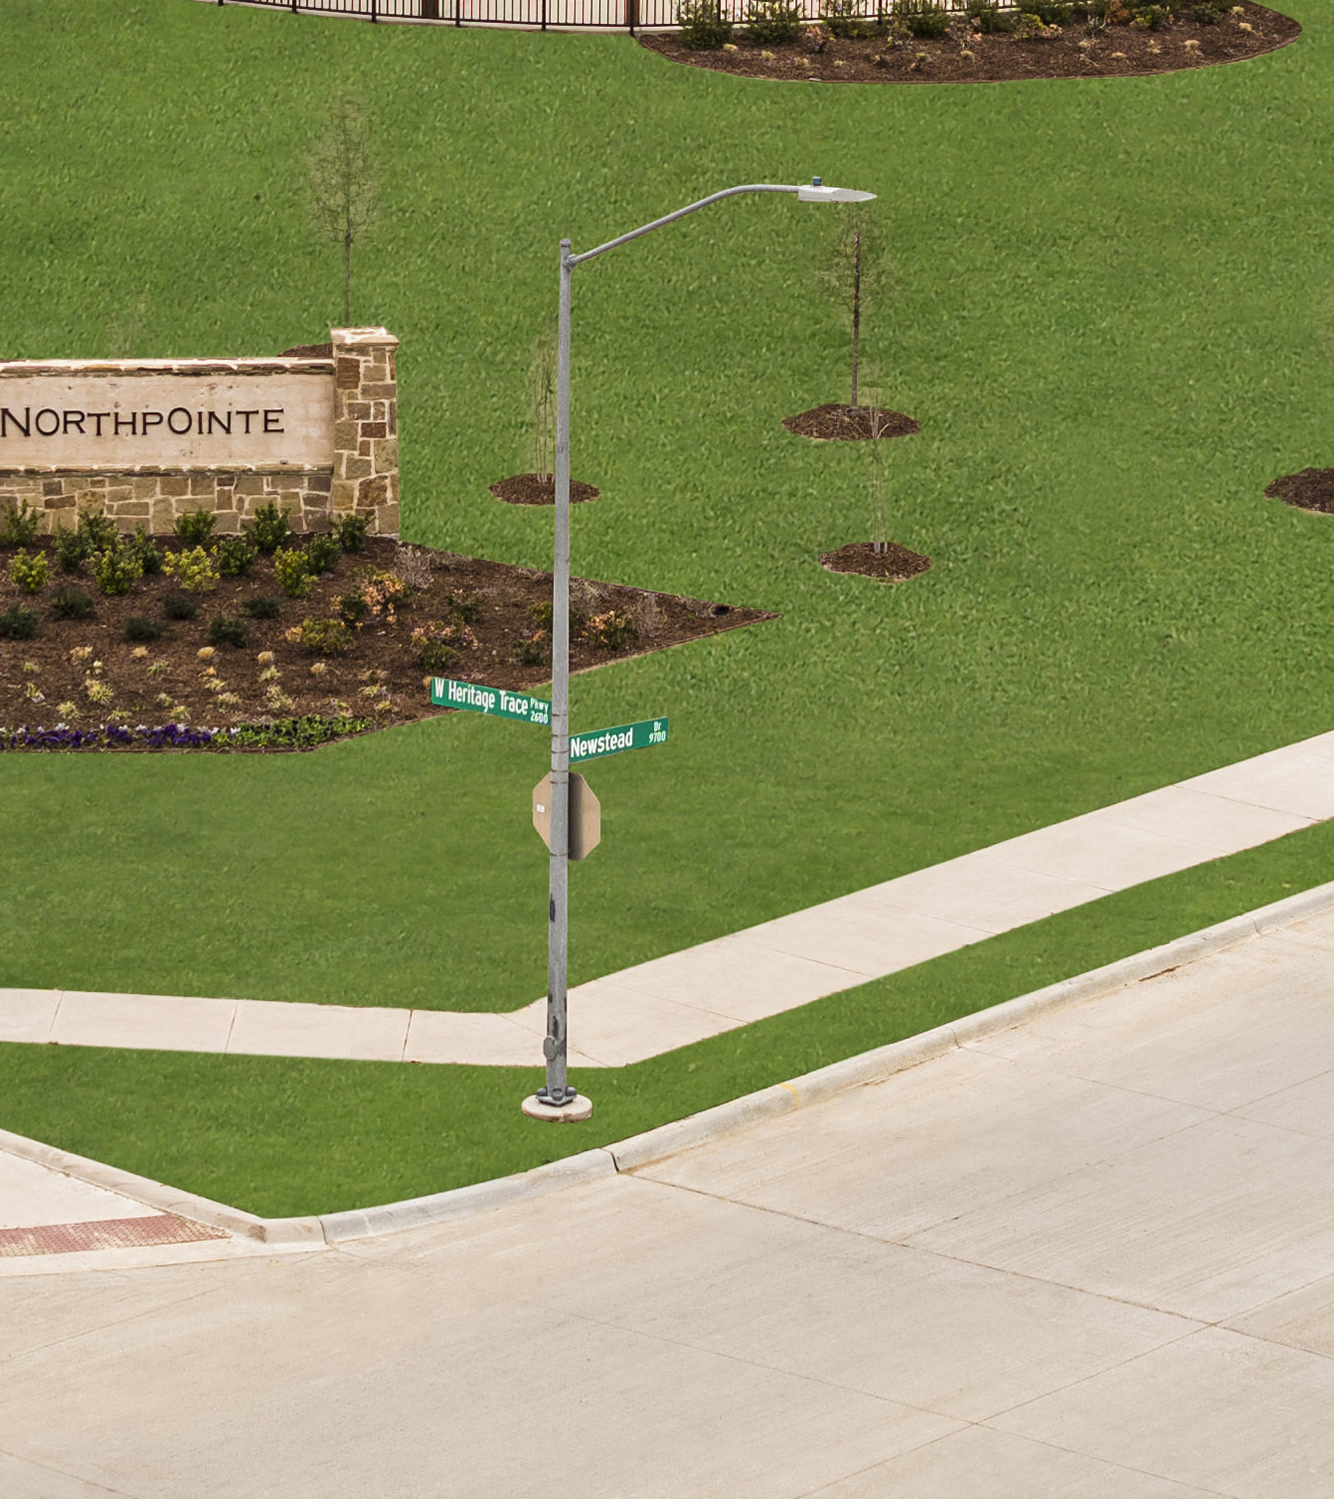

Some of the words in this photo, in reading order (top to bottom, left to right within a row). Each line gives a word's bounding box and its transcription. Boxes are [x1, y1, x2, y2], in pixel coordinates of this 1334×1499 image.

[434, 680, 444, 698] W
[448, 681, 496, 713] Heritage
[499, 690, 529, 716] Trace
[530, 697, 550, 713] Pkwy
[530, 711, 549, 724] 2600
[653, 720, 662, 732] Dr
[570, 727, 633, 759] Newstead
[648, 730, 667, 744] 9700
